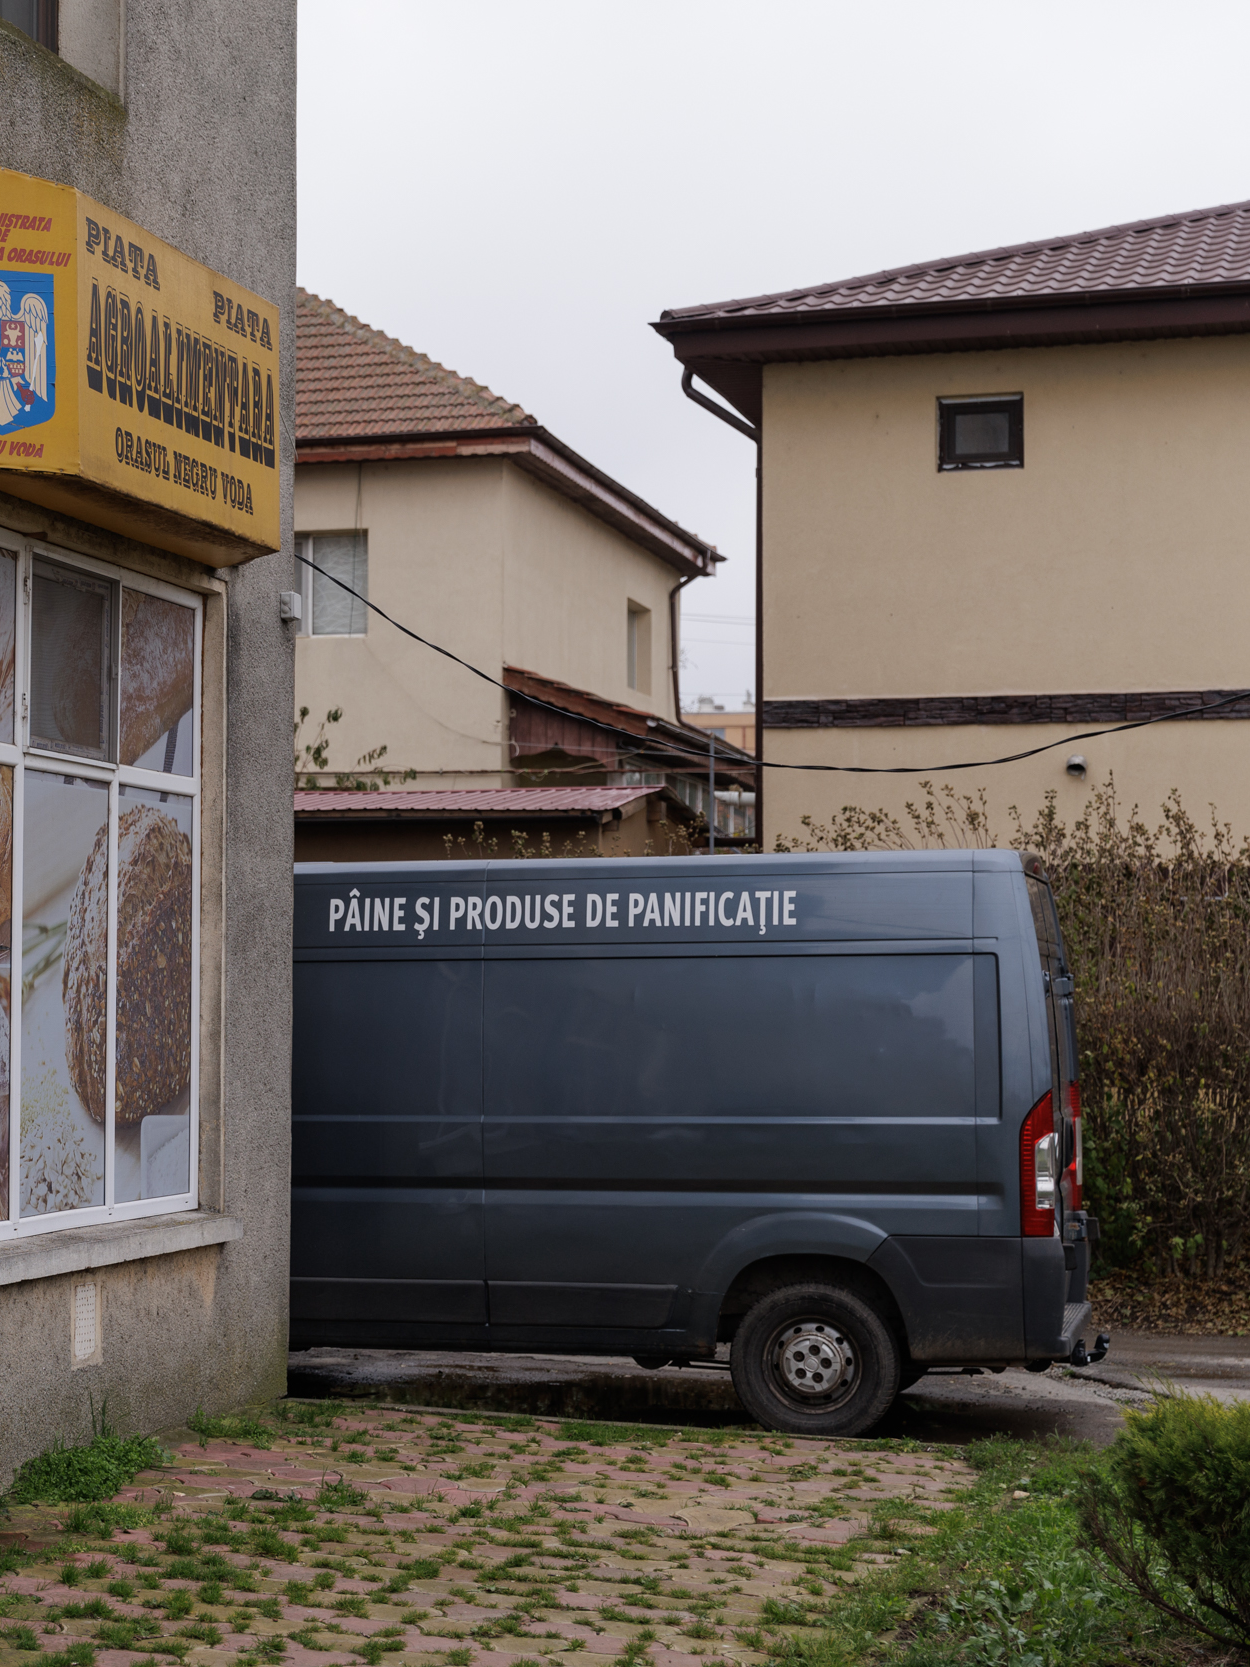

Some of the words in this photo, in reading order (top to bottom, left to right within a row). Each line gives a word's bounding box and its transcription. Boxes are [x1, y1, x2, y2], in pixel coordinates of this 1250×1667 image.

[7, 248, 72, 267] ORASULUI
[86, 217, 160, 290] PIATA
[213, 290, 273, 351] PIATA
[87, 278, 275, 469] AGROALIMENTARA
[9, 441, 44, 458] VODA
[115, 427, 170, 481] ORASUL
[173, 451, 217, 500] NEGRU
[221, 471, 253, 515] VODA
[328, 888, 406, 932] PÂINE
[449, 893, 575, 931] PRODUSE
[585, 893, 619, 928] DE
